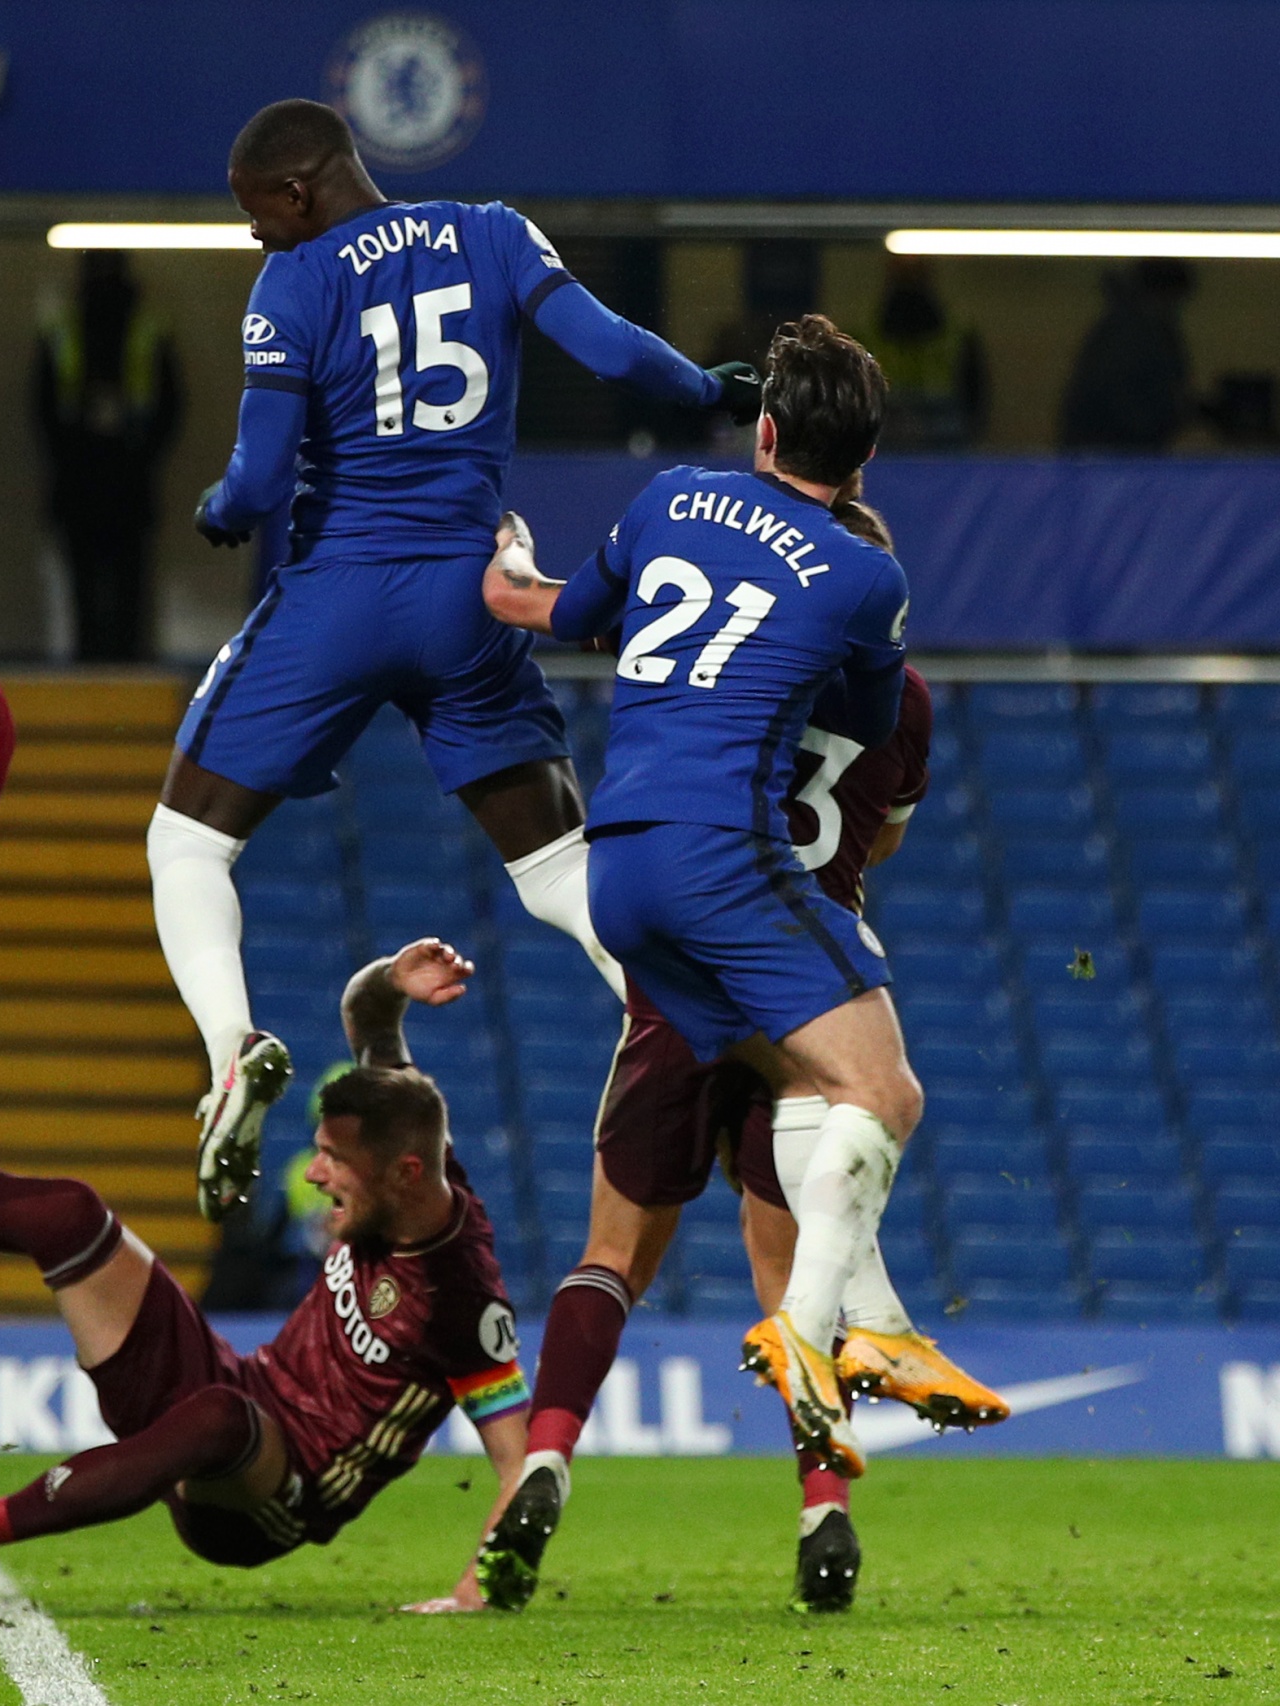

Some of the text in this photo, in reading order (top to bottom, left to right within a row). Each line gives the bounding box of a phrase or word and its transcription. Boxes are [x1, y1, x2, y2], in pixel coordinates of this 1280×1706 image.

[338, 216, 458, 276] ZOUMA
[360, 282, 489, 437] 15
[667, 491, 830, 588] CHILWELL
[616, 555, 777, 689] 21
[323, 1243, 391, 1366] SBOTOP
